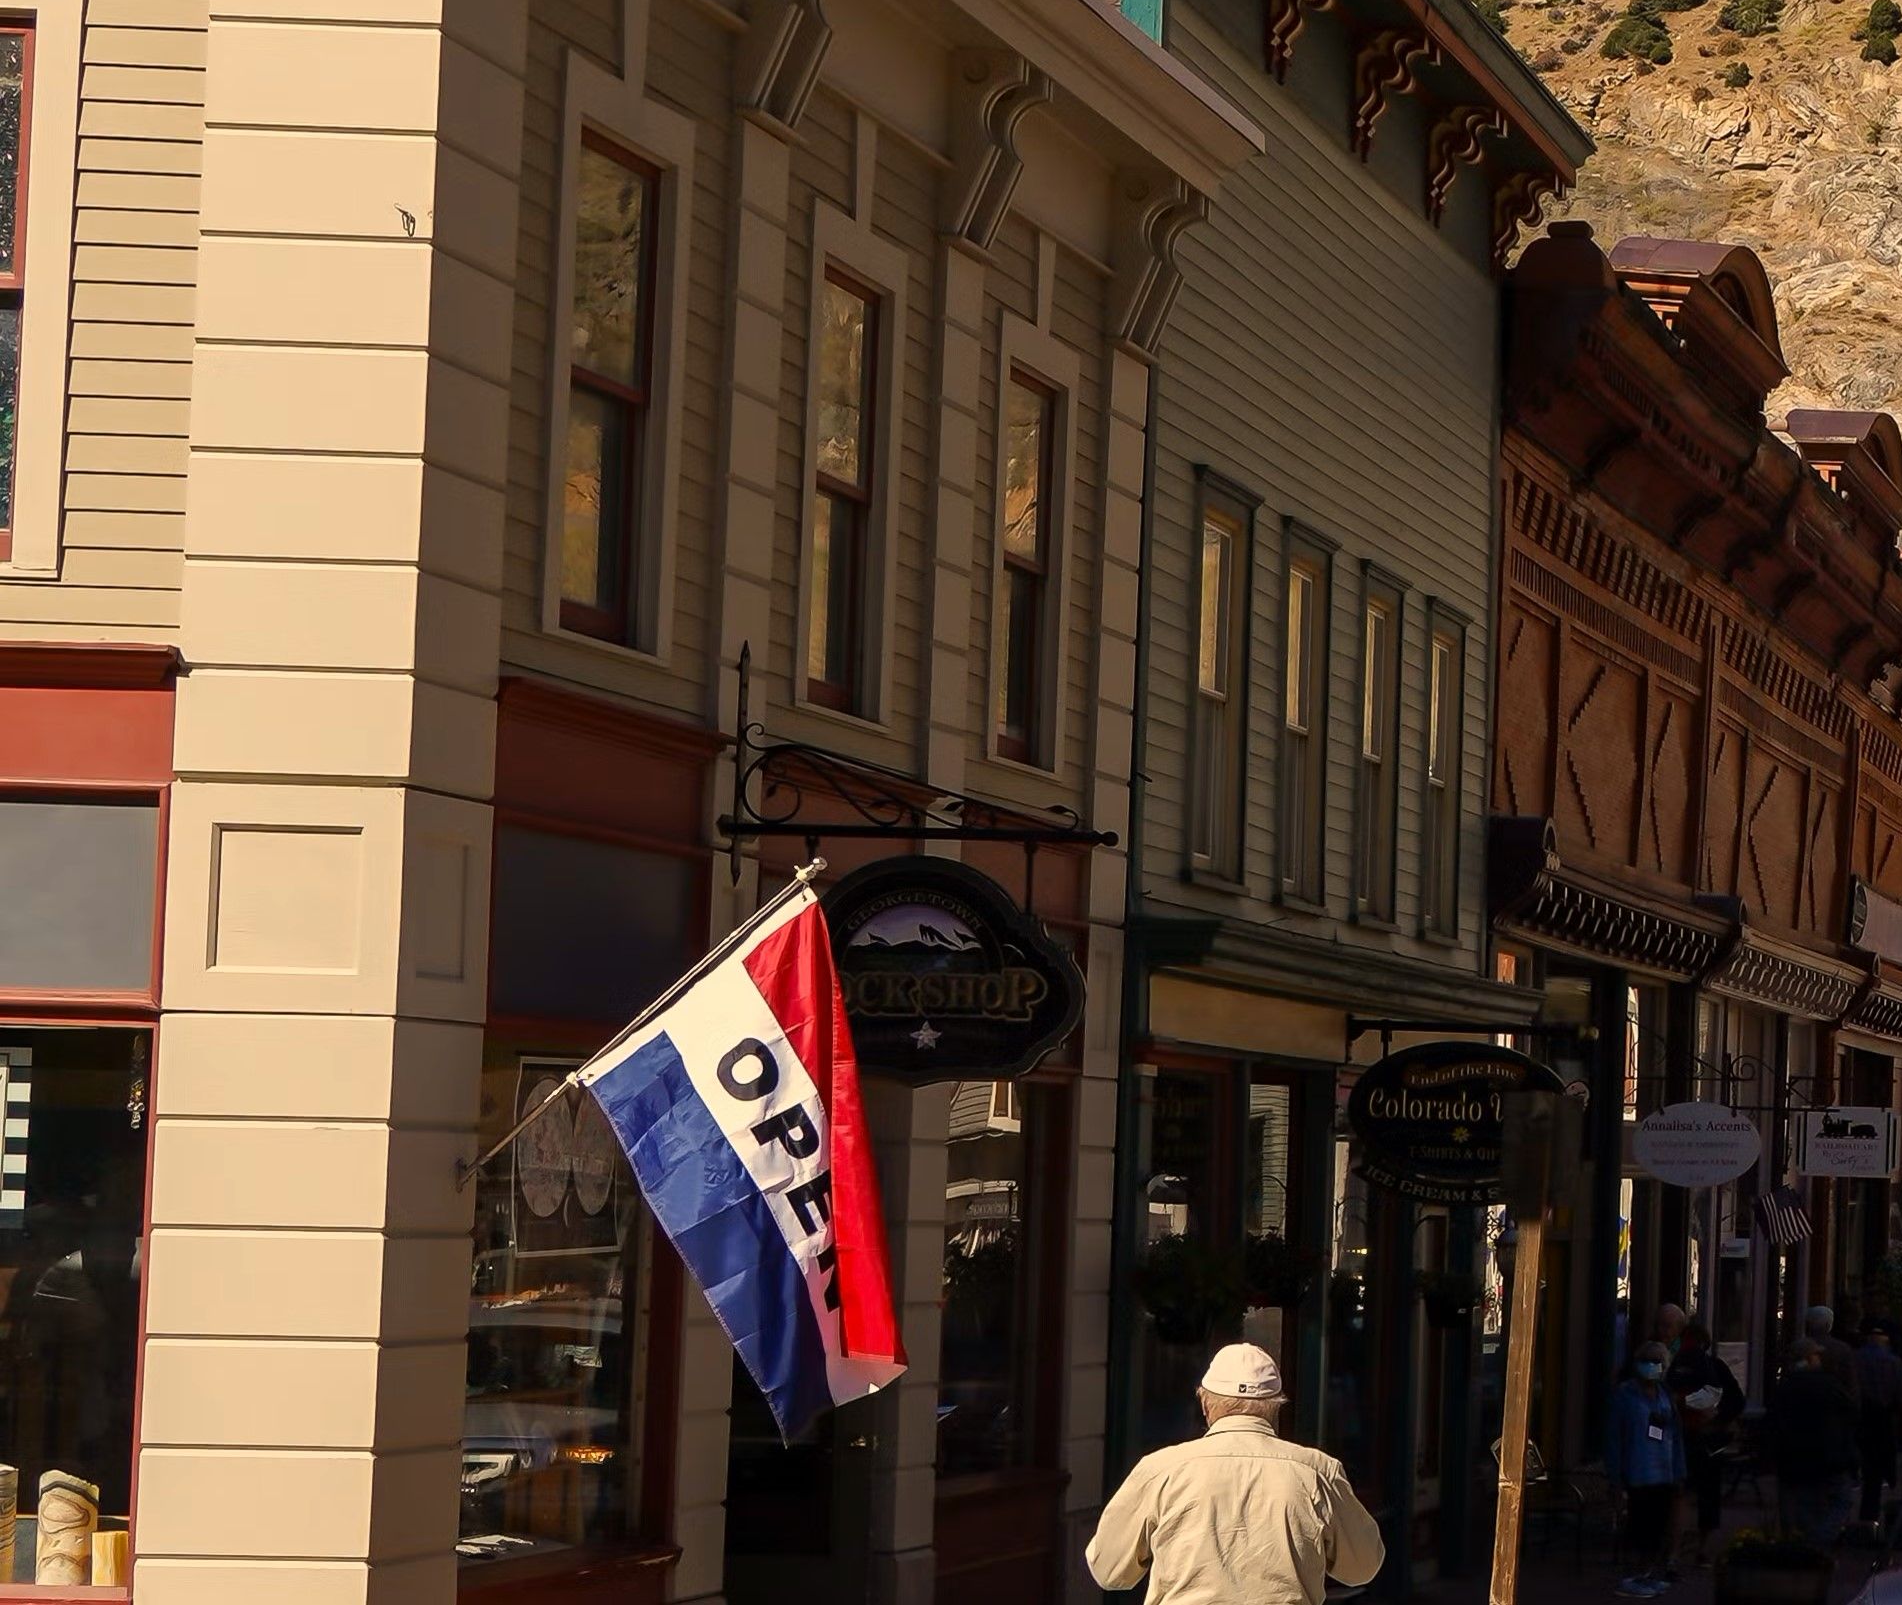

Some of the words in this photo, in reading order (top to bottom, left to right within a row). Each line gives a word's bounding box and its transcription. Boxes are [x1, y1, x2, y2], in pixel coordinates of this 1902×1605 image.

[1368, 1086, 1483, 1123] Colorado
[1641, 1119, 1702, 1132] Annalisa's
[1706, 1120, 1752, 1132] Accents
[1398, 1180, 1468, 1203] CREAM
